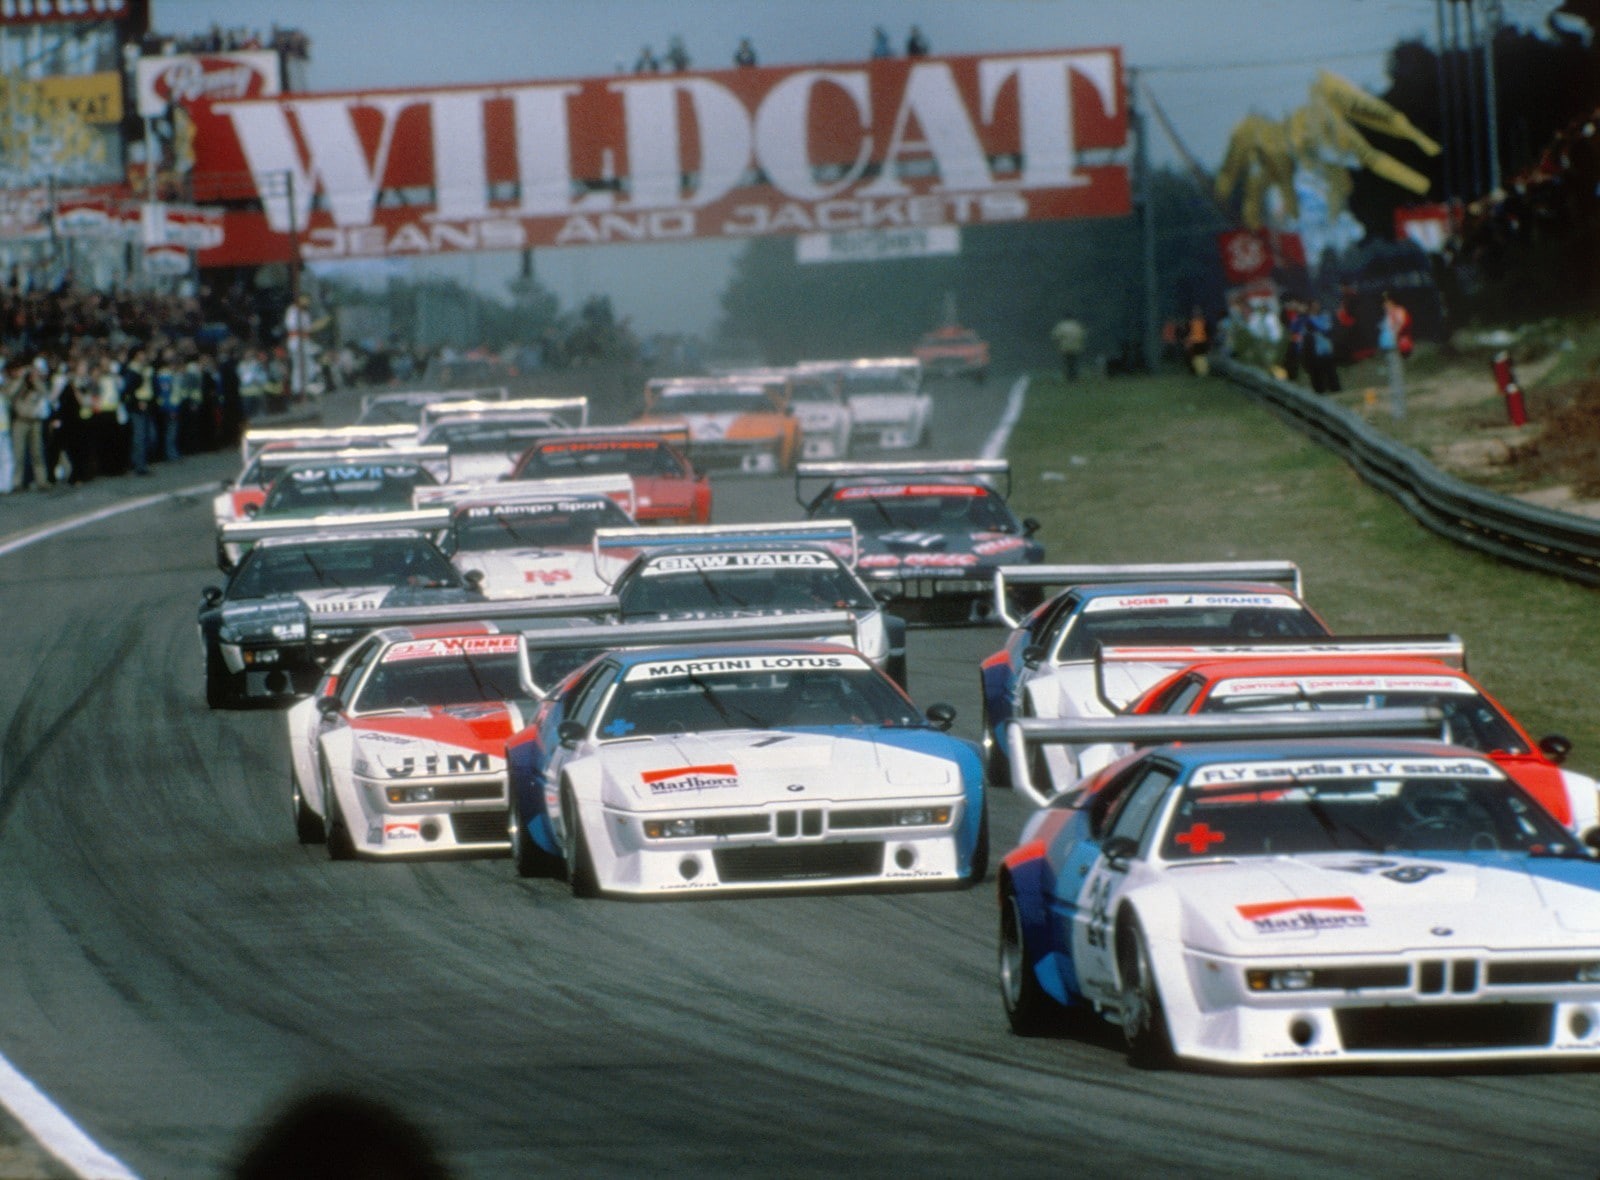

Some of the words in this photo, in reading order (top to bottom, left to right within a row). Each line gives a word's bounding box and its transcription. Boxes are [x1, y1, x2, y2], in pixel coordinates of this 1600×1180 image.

[212, 51, 1117, 233] WILDCAT
[301, 217, 527, 257] JEANS
[556, 209, 696, 245] AND
[722, 192, 1030, 235] JACKETS
[557, 500, 606, 512] Sport
[659, 555, 728, 571] BMW
[737, 553, 816, 566] ITALIA
[1119, 597, 1169, 606] LIGIER
[649, 659, 750, 676] MARTINI
[762, 657, 843, 669] LOTUS
[1203, 767, 1248, 782] FLY
[1254, 762, 1344, 778] saudia
[1350, 762, 1395, 775] FLY
[1400, 761, 1490, 776] saudia
[650, 776, 739, 792] Marlboro
[1253, 911, 1368, 931] Marlboro
